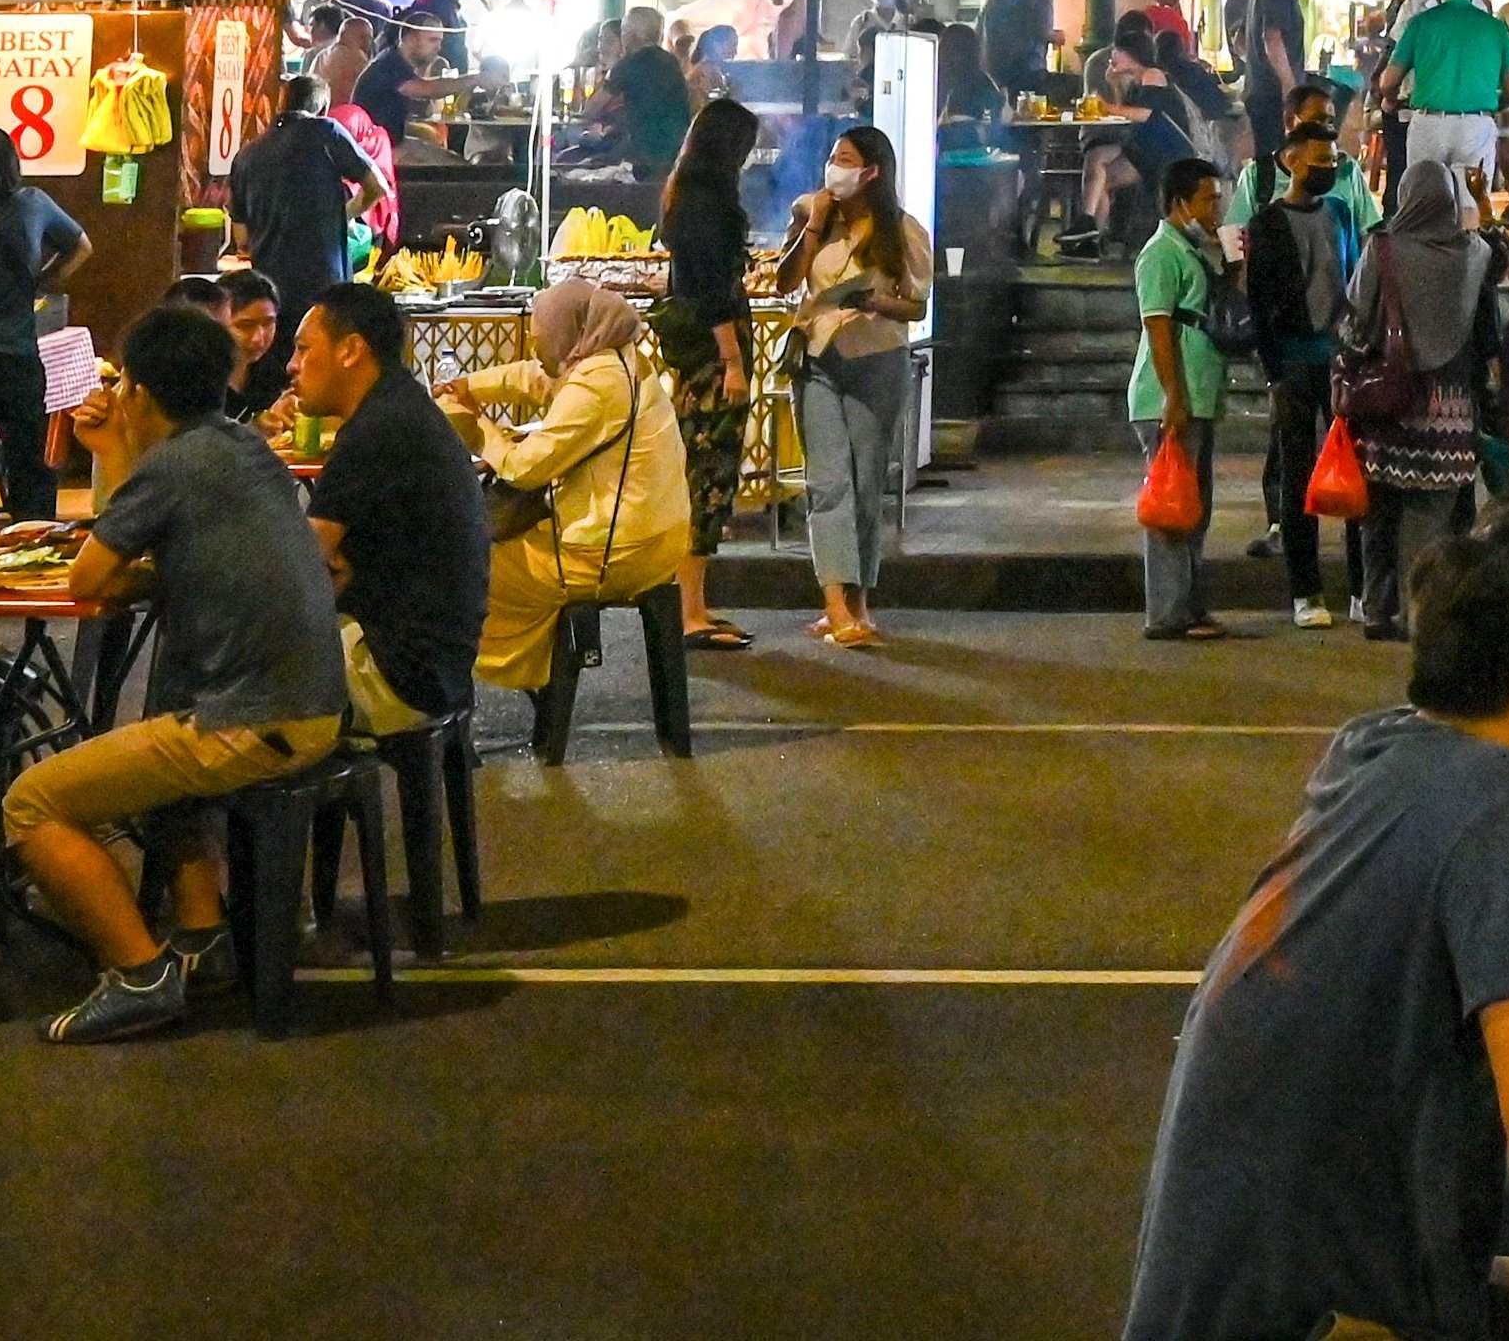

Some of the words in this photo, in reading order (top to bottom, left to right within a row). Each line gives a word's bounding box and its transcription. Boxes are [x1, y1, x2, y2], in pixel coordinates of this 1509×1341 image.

[0, 31, 73, 52] BEST
[10, 85, 55, 160] 8
[219, 88, 234, 159] 8
